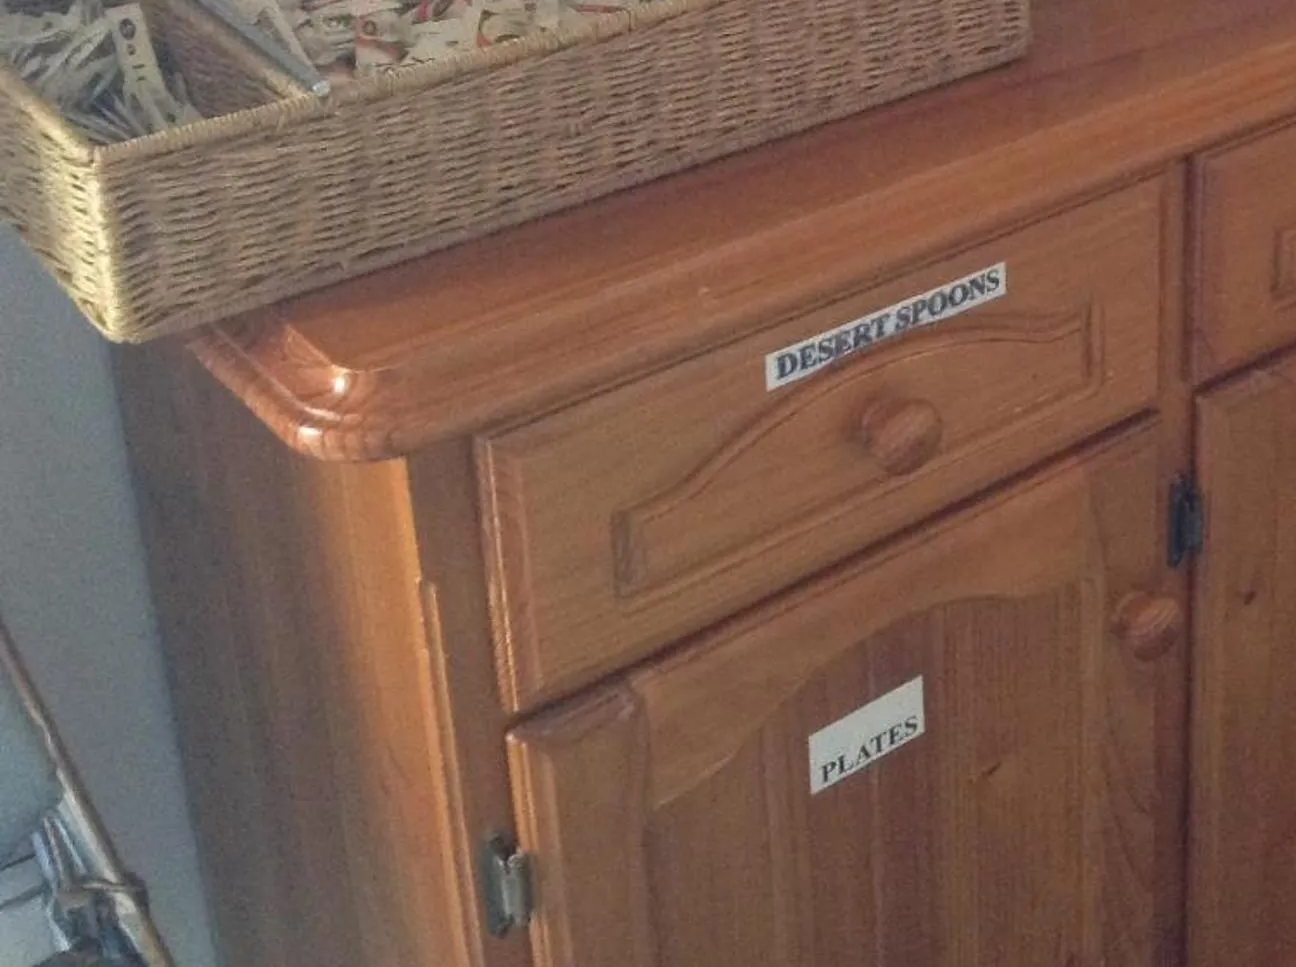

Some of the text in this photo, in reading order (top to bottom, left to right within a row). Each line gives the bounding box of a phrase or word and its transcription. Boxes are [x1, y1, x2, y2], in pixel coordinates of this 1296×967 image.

[776, 268, 1001, 379] DESERT SPOONS
[821, 715, 918, 782] PLATES
